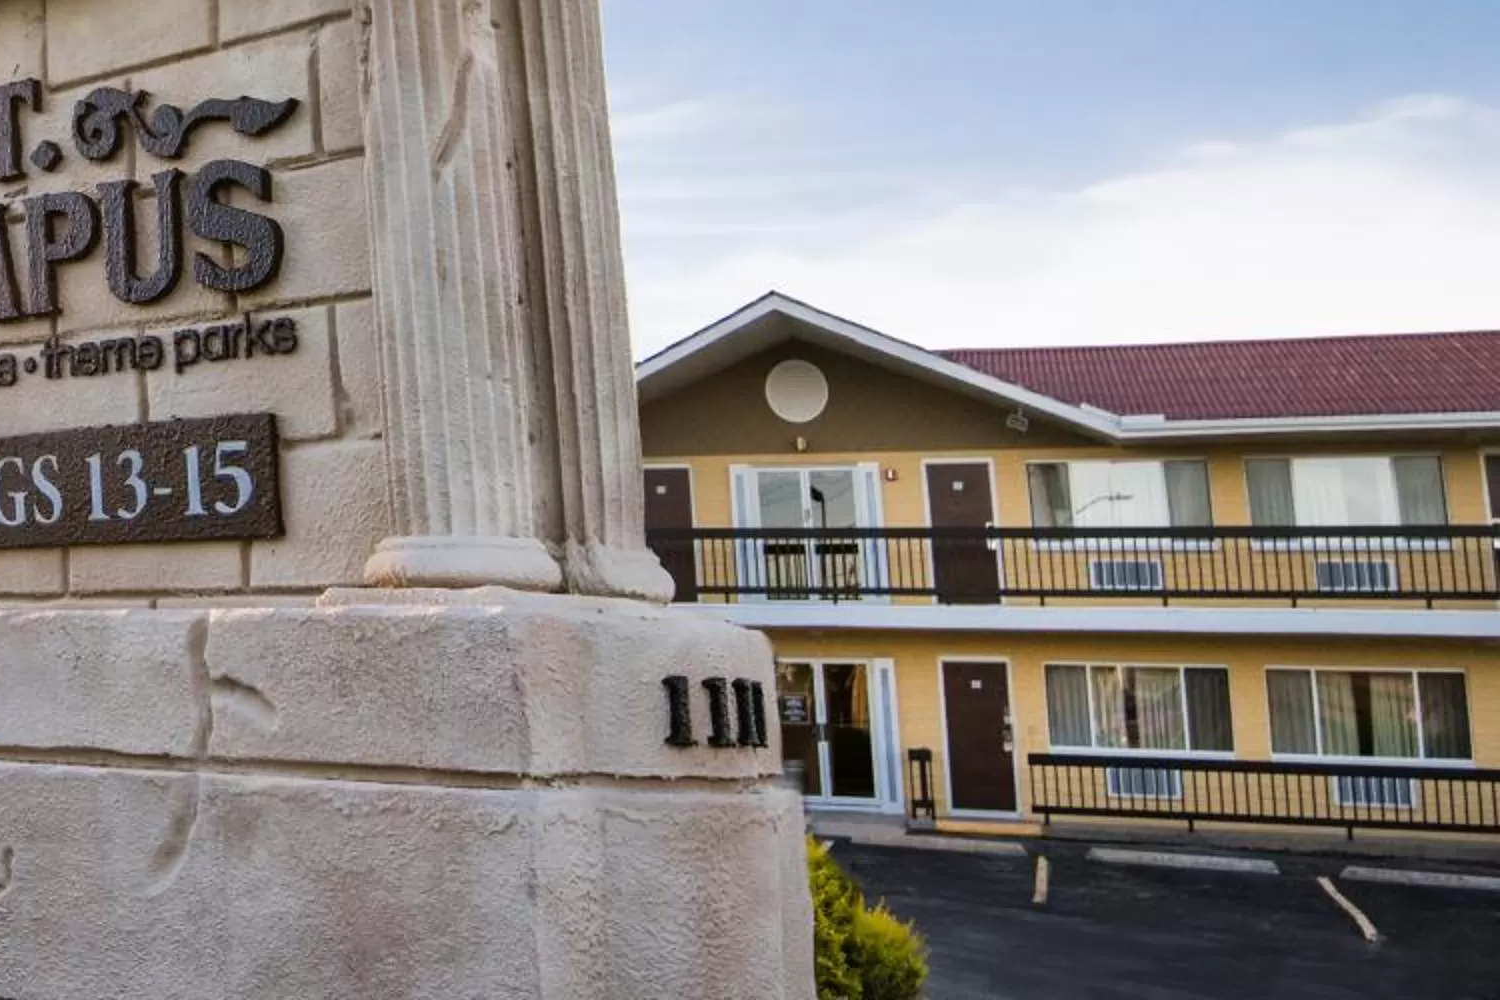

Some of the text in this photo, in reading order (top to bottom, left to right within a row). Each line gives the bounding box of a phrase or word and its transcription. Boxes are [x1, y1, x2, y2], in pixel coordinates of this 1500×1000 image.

[40, 334, 164, 380] theme
[173, 310, 299, 376] parks
[85, 439, 256, 523] 13-15
